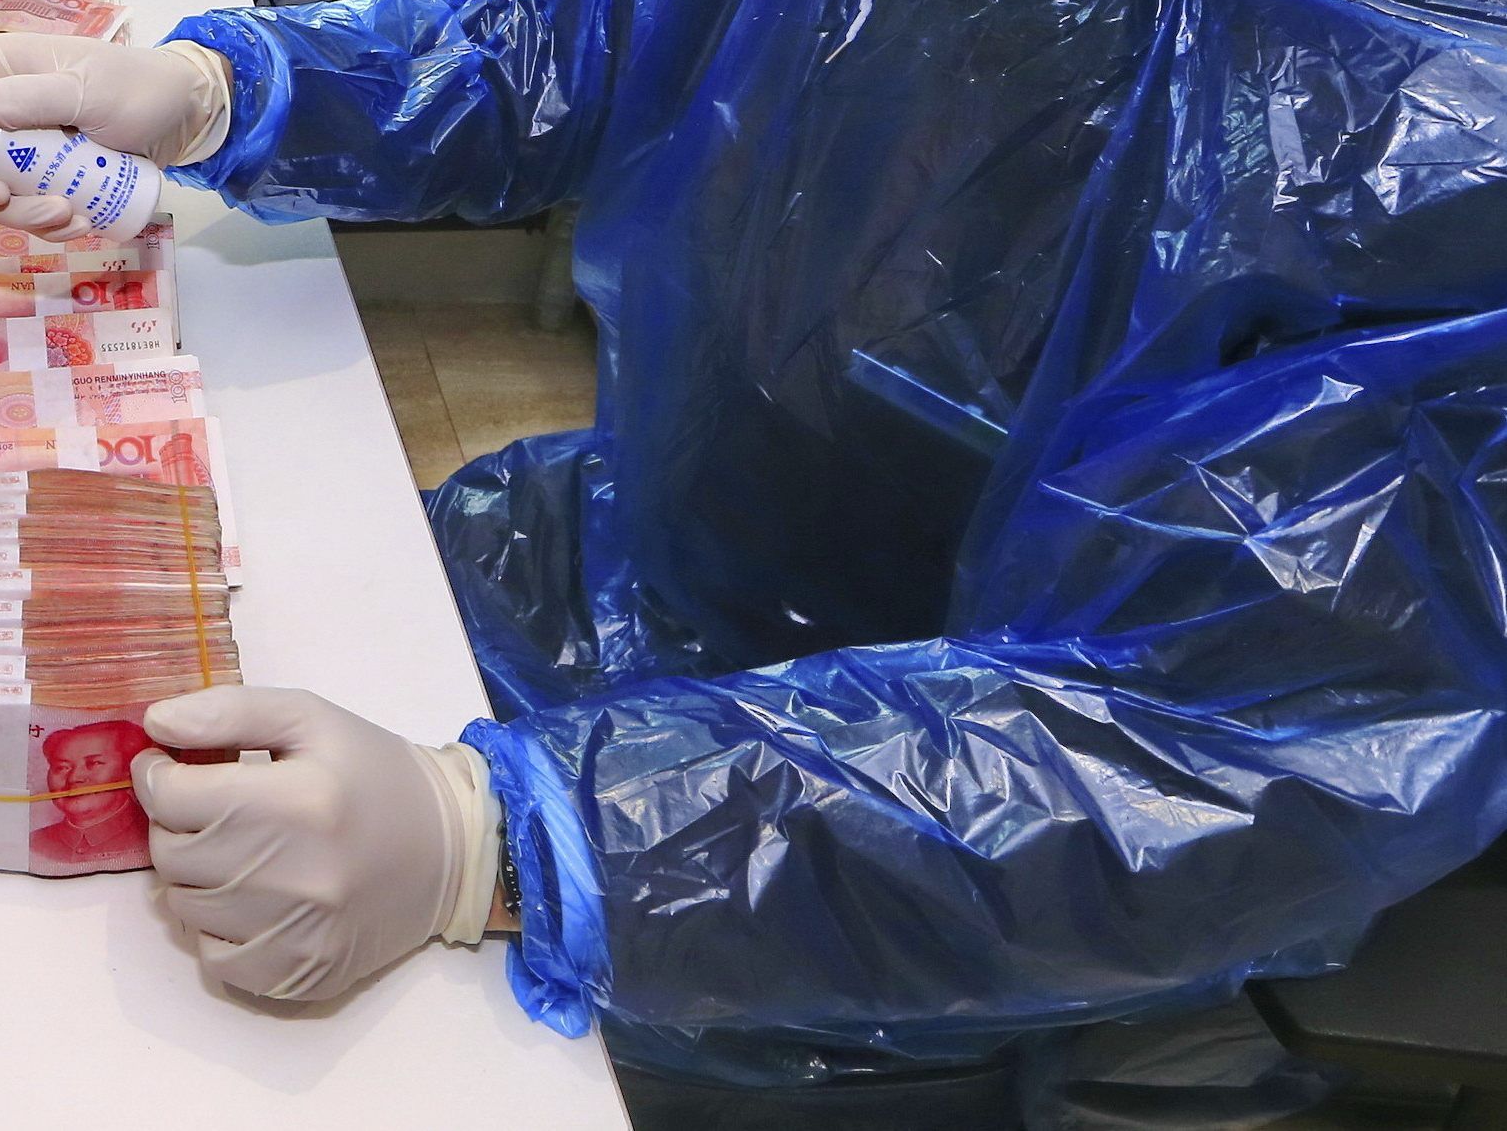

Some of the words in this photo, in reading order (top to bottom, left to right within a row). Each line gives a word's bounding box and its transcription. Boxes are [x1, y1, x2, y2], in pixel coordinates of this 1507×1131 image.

[100, 340, 160, 352] H8E1812535
[94, 373, 129, 384] RENMIN
[128, 371, 167, 382] YINHANG
